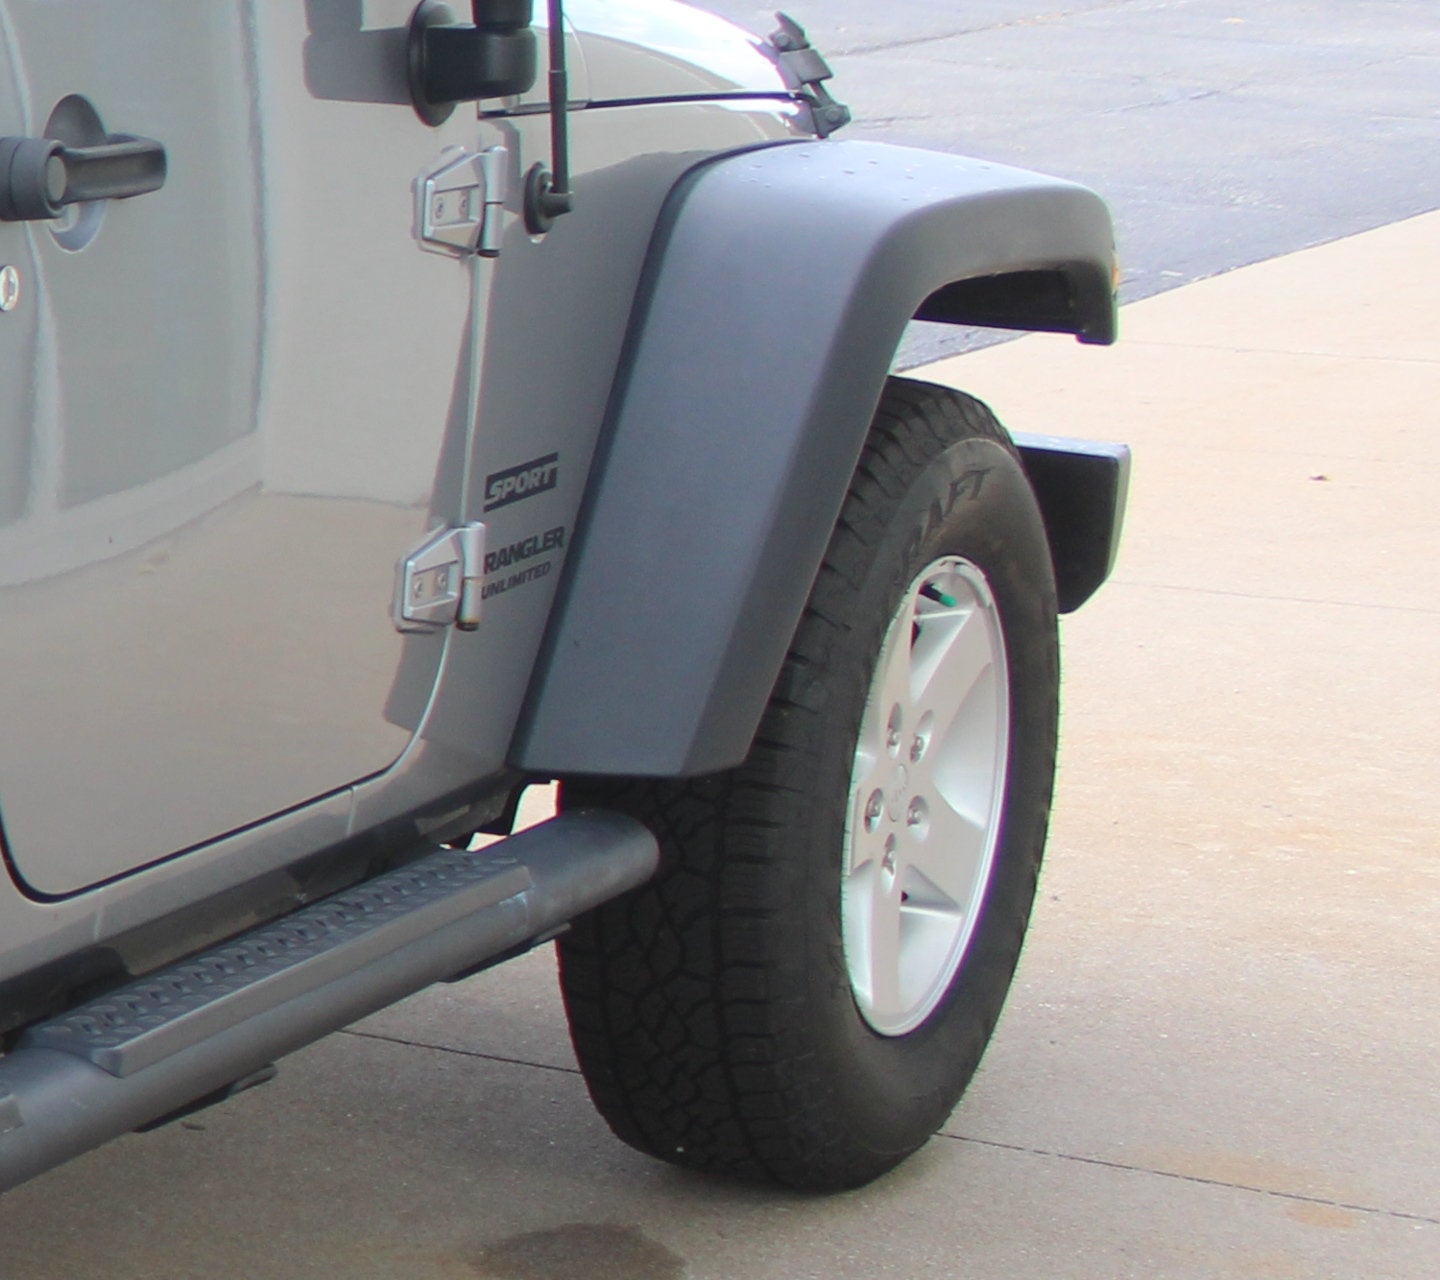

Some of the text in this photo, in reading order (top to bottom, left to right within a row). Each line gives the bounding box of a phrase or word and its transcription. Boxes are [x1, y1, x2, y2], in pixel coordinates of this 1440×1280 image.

[483, 461, 558, 505] SPORT
[484, 525, 566, 575] RANGLER
[480, 560, 552, 600] UNLIMITED
